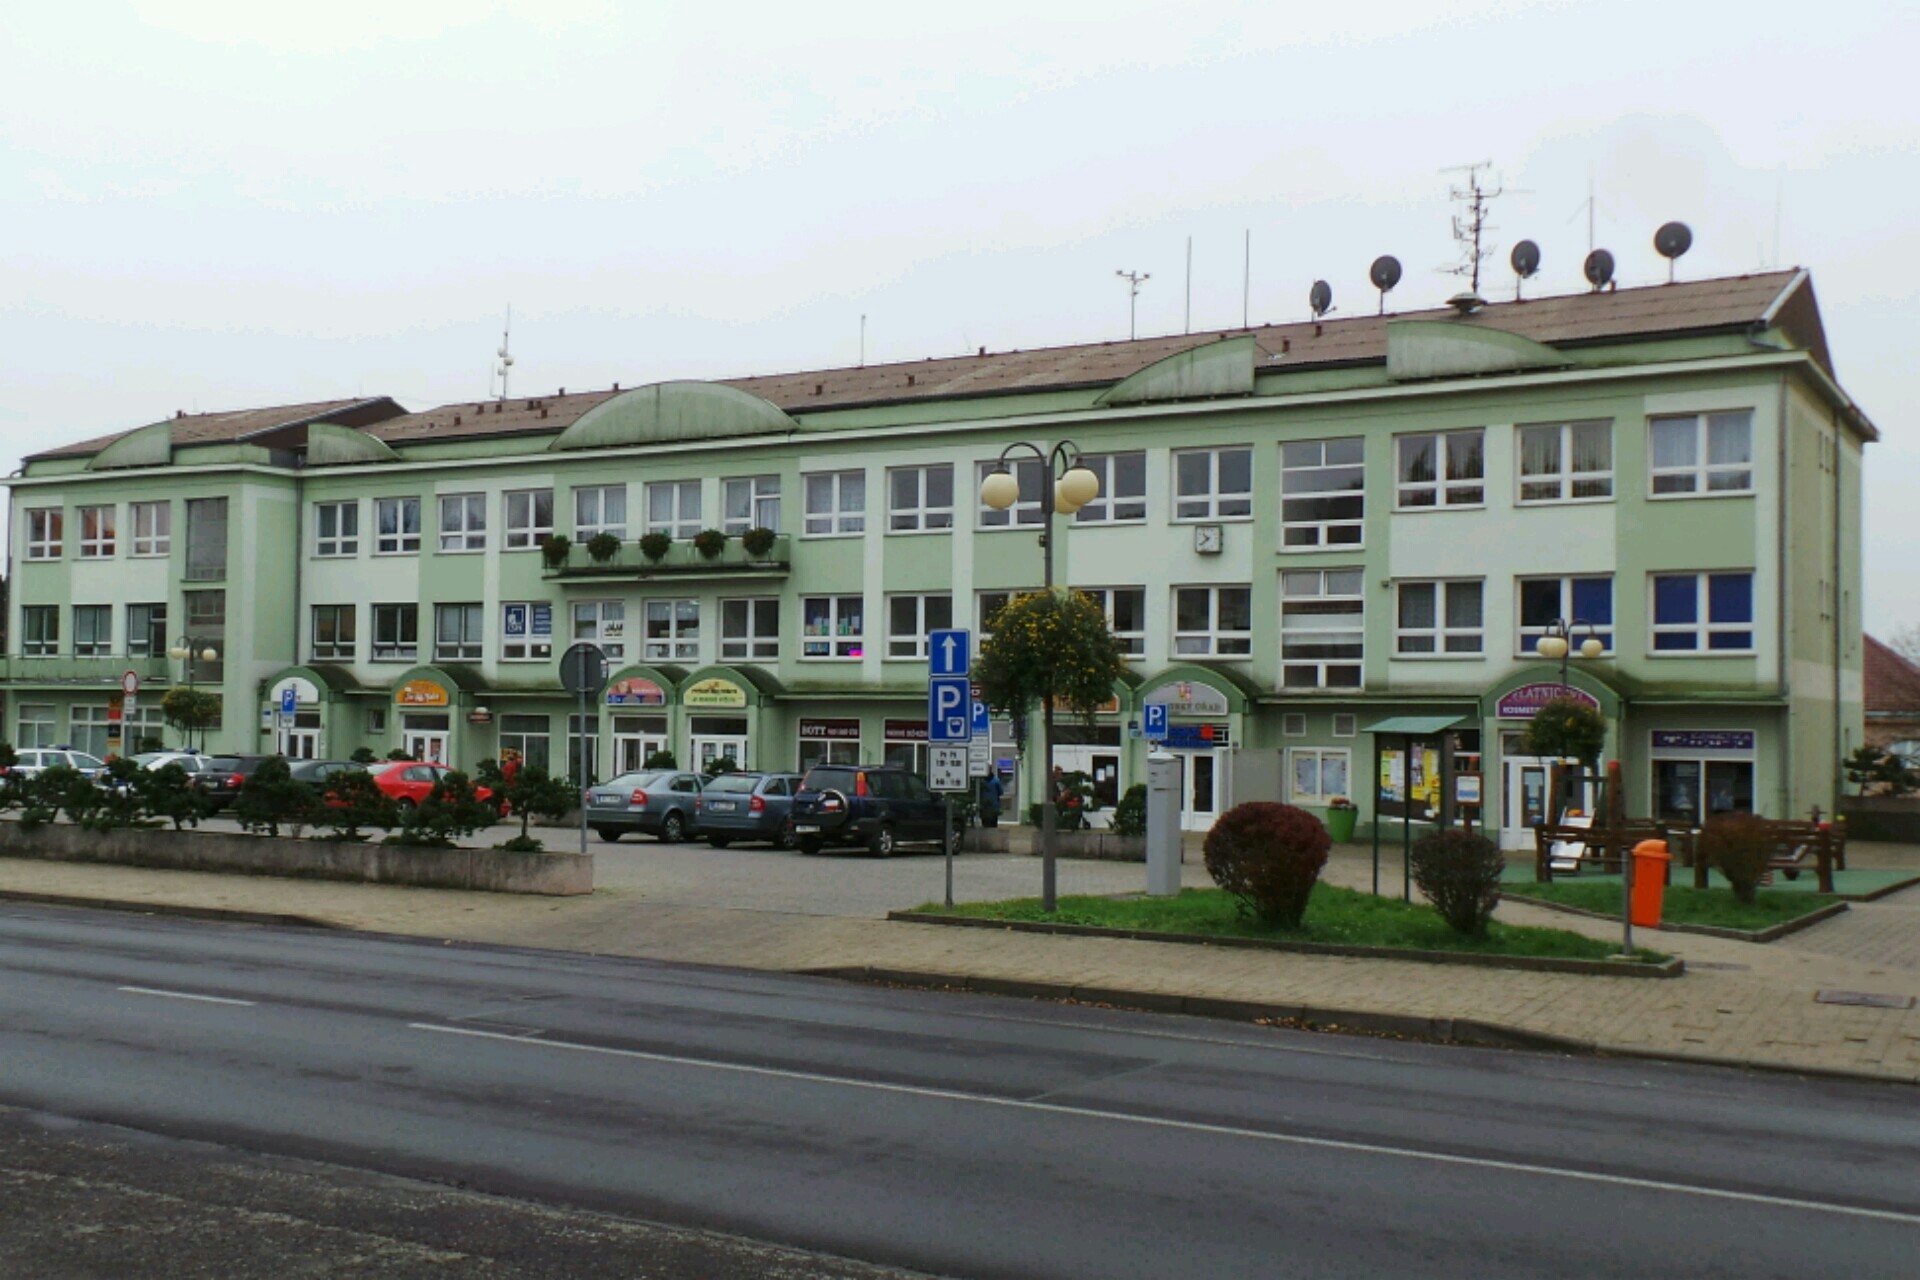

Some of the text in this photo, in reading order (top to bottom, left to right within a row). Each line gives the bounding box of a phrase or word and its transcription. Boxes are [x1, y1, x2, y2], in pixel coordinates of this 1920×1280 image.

[938, 685, 961, 722] P
[973, 702, 984, 722] P
[1149, 706, 1162, 726] P
